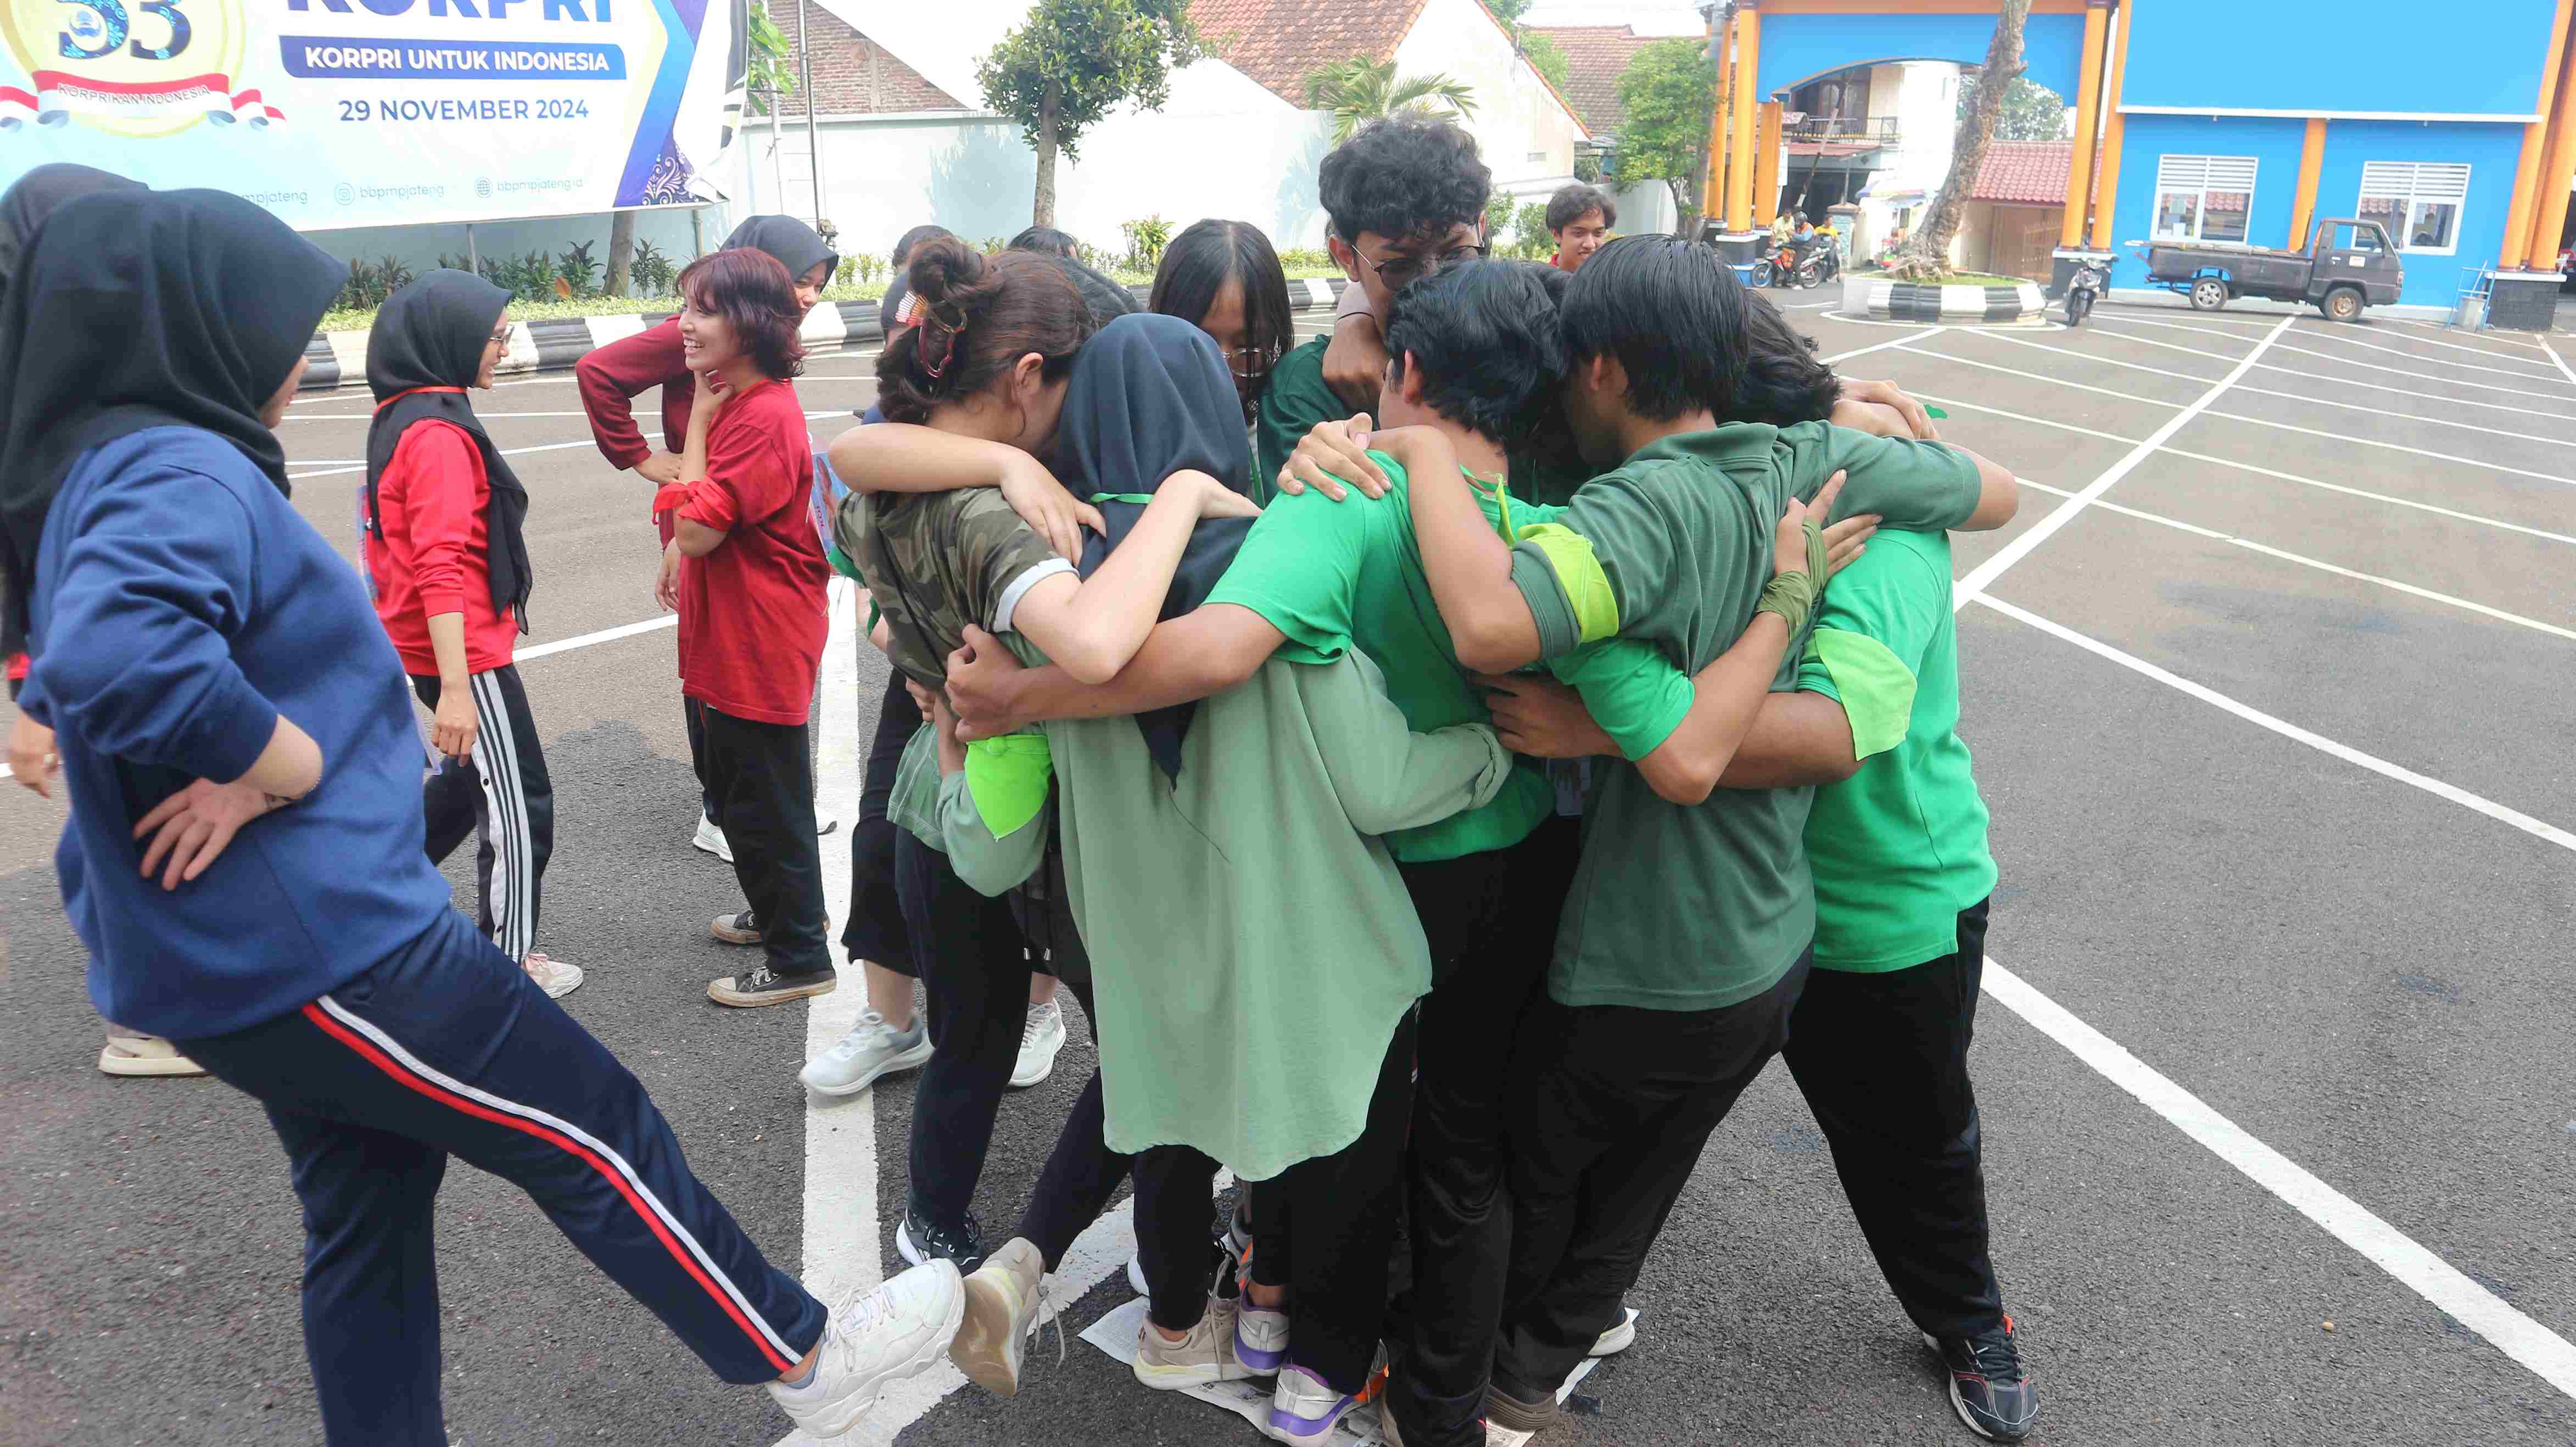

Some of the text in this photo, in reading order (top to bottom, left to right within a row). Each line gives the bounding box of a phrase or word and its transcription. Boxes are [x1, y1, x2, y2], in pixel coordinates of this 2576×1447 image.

[305, 47, 610, 70] KORPRI UNTUK INDONESIA
[143, 85, 211, 104] INDONESIA
[338, 99, 589, 121] 29 NOVEMBER 2024
[360, 184, 444, 202] bbpmpjateng
[497, 177, 583, 193] bbpmpjatengid
